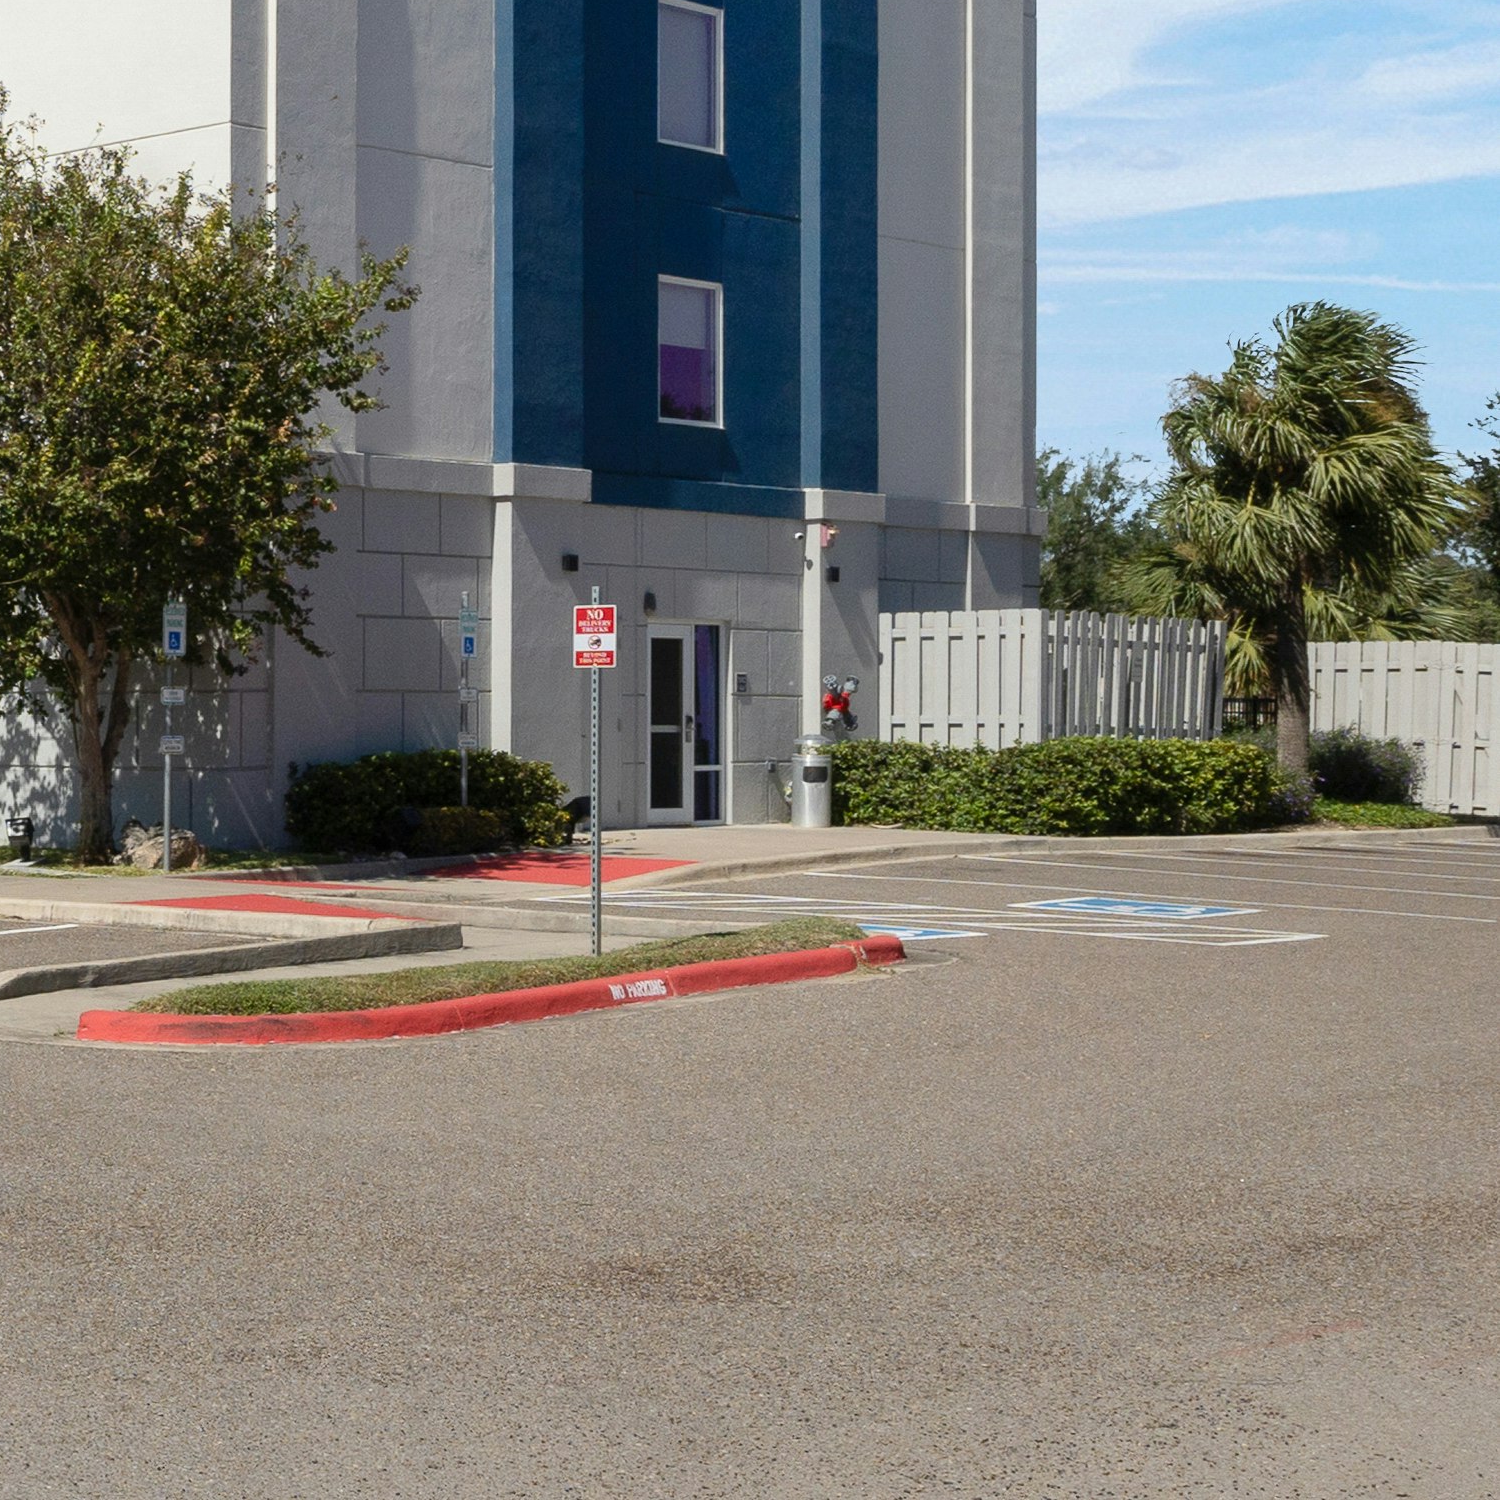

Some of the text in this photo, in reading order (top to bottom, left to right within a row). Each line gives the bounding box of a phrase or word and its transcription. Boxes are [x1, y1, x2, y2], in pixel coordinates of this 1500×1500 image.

[586, 609, 604, 620] NO
[609, 979, 668, 1000] NO PARKING
